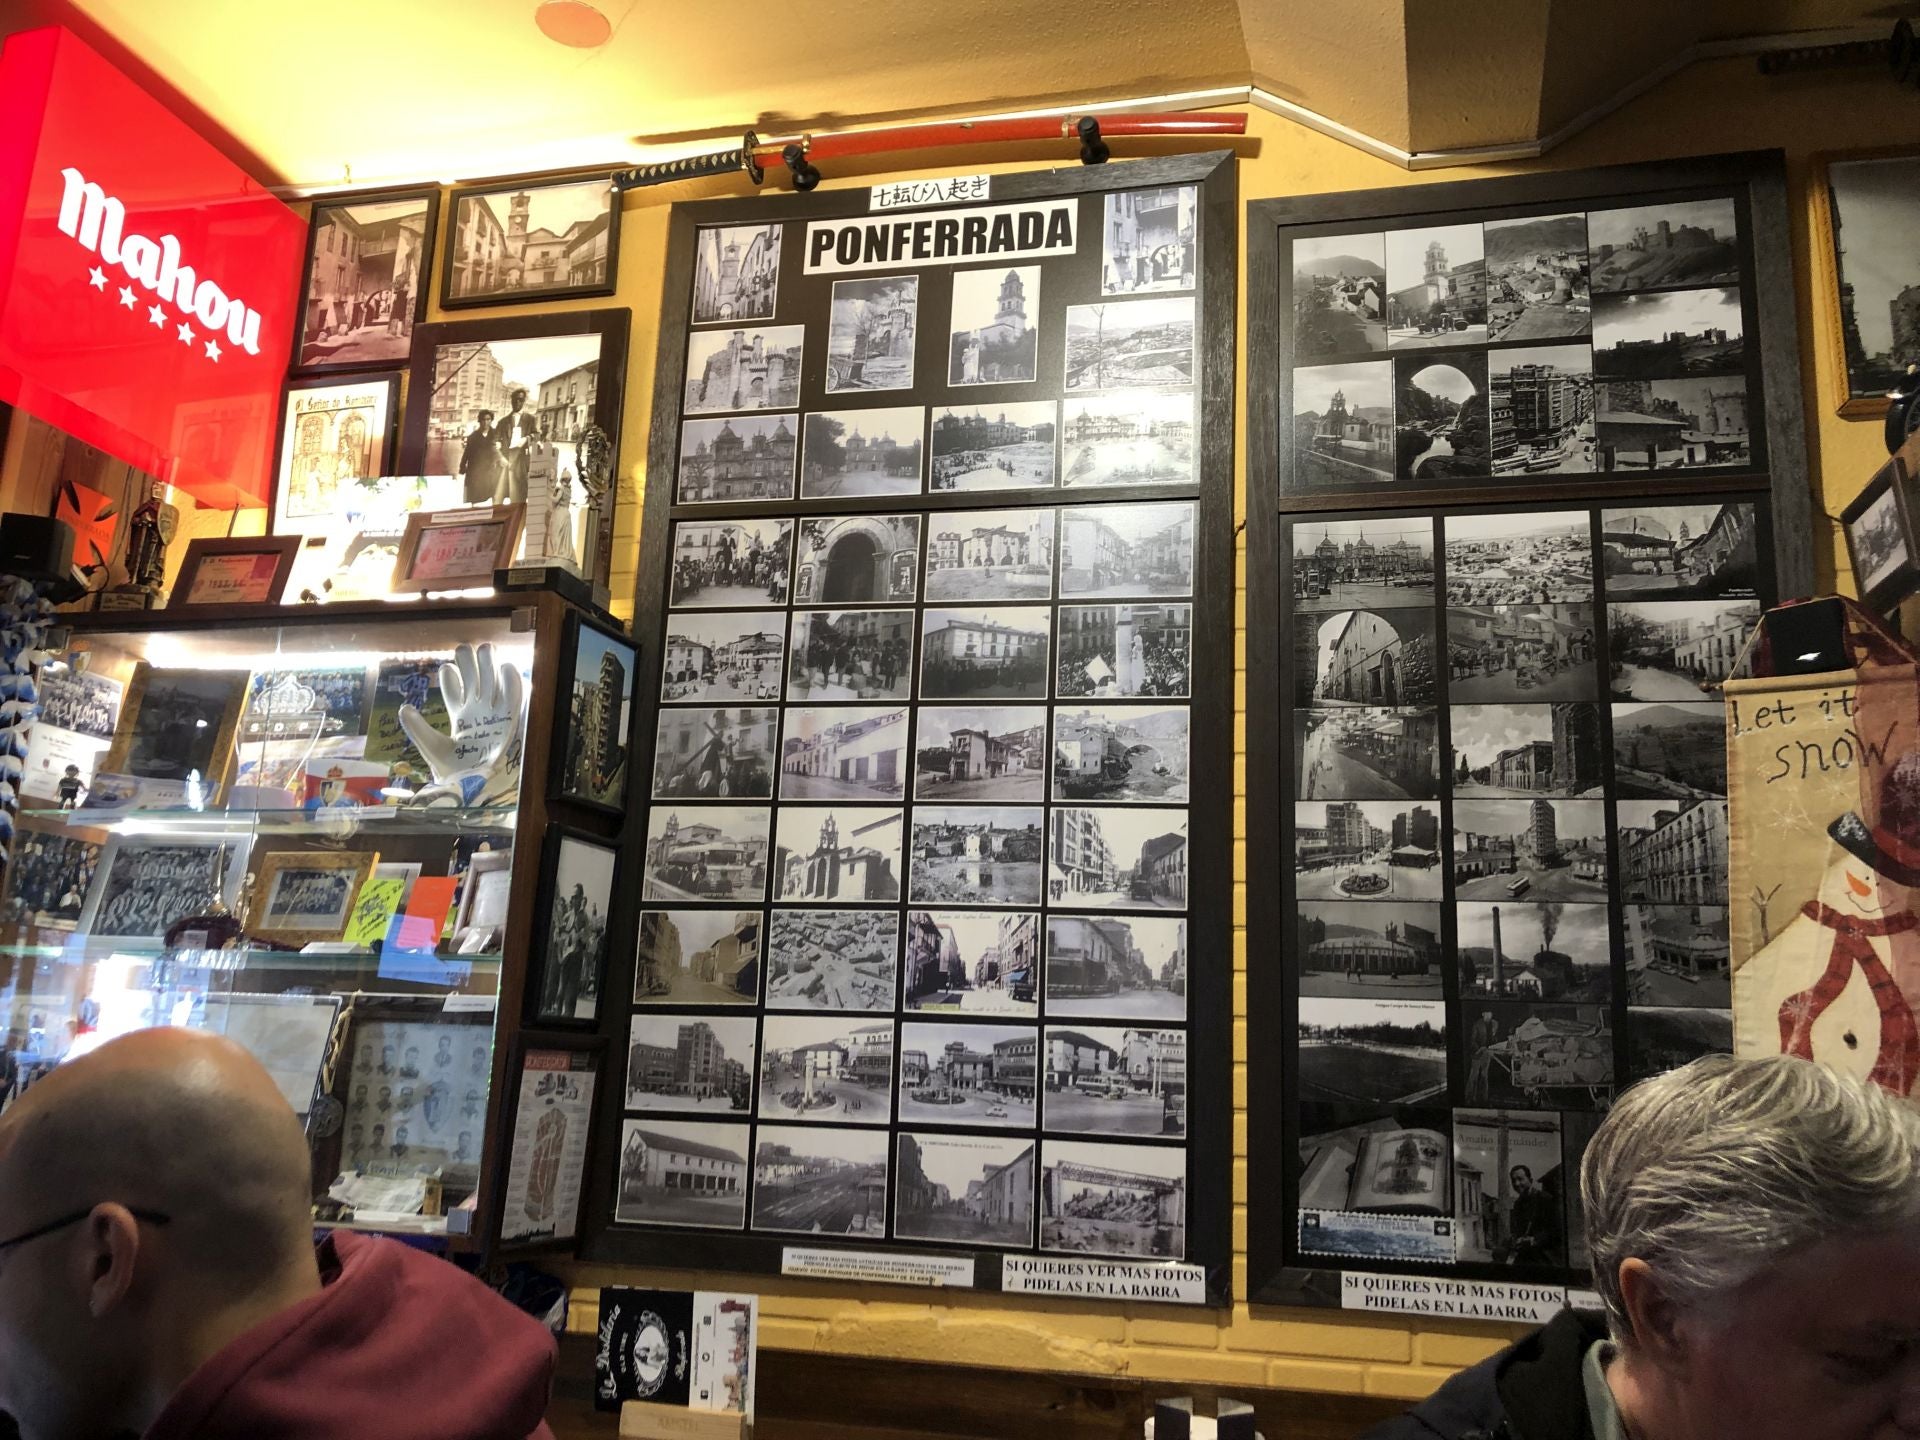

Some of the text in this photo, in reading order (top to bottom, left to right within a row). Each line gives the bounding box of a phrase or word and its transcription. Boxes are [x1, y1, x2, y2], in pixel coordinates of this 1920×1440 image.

[872, 176, 988, 207] 七転び八起き
[810, 208, 1073, 267] PONFERRADA
[58, 168, 261, 355] Mahou
[1732, 689, 1859, 736] Let it
[1006, 1260, 1202, 1282] SI QUIERES VER MAS FOTOS
[1023, 1278, 1180, 1298] PIDELAS EN LA BARRA
[1345, 1276, 1562, 1303] SI QUIERES VER MAS FOTOS
[1365, 1295, 1538, 1320] PIDELAS EN LA BARRA
